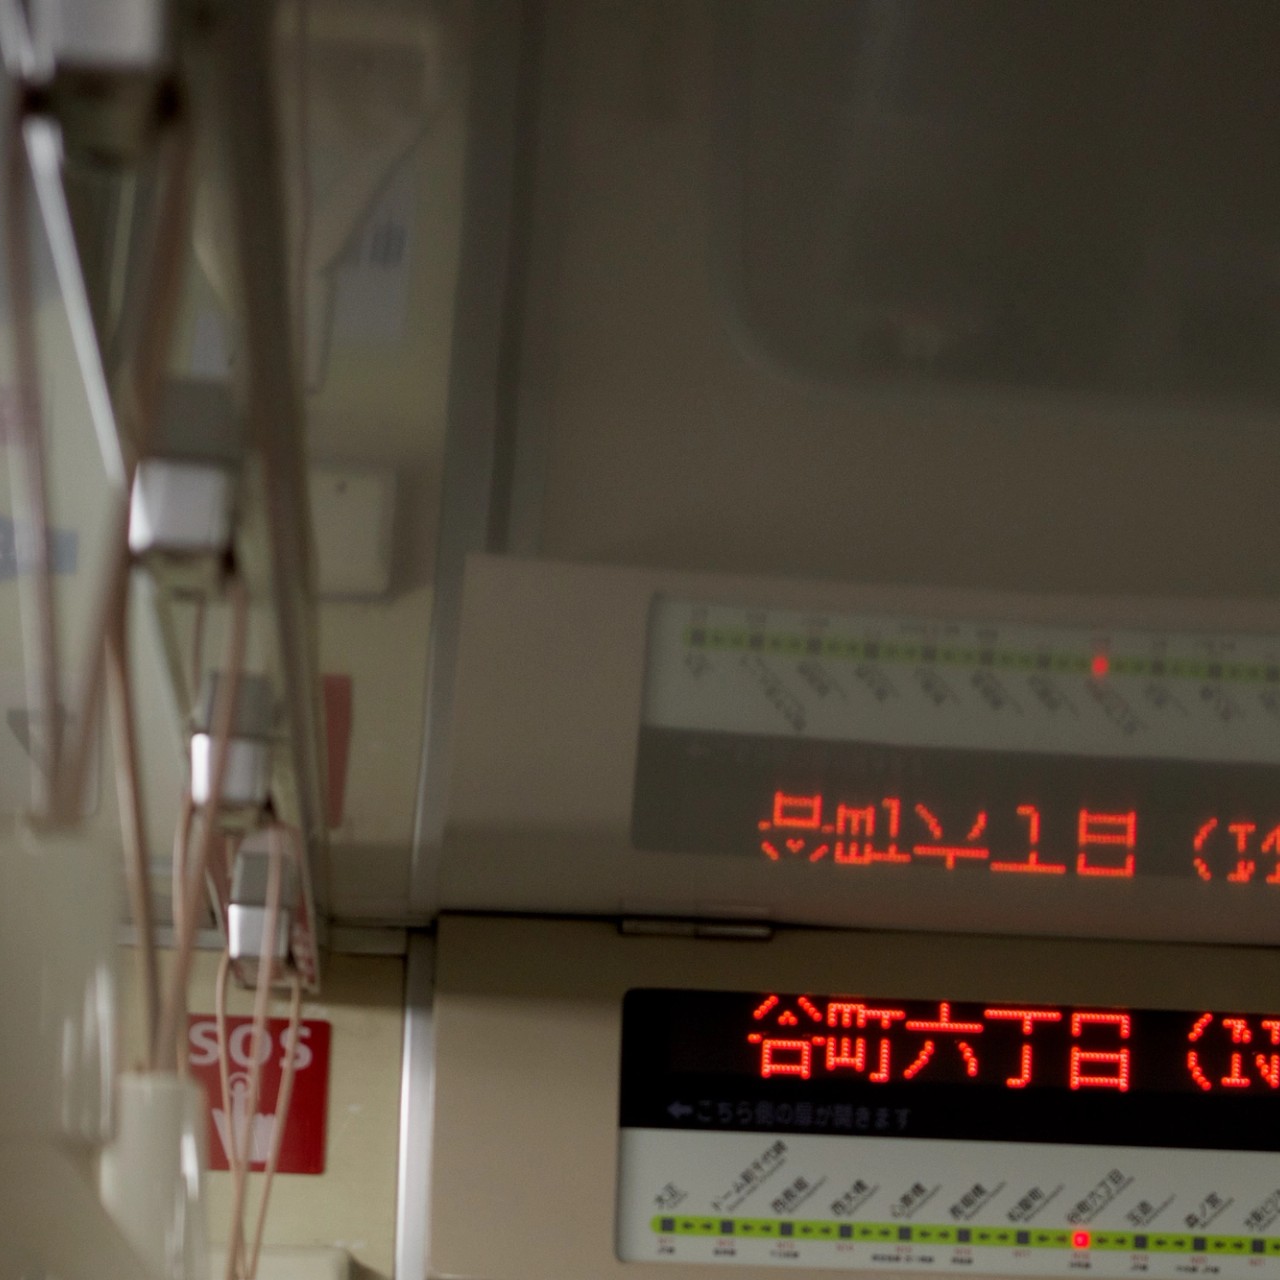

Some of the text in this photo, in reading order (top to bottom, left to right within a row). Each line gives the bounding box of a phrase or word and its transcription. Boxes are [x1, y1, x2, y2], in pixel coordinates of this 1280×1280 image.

[188, 1020, 314, 1071] SOS
[748, 993, 1132, 1092] 谷町六丁目
